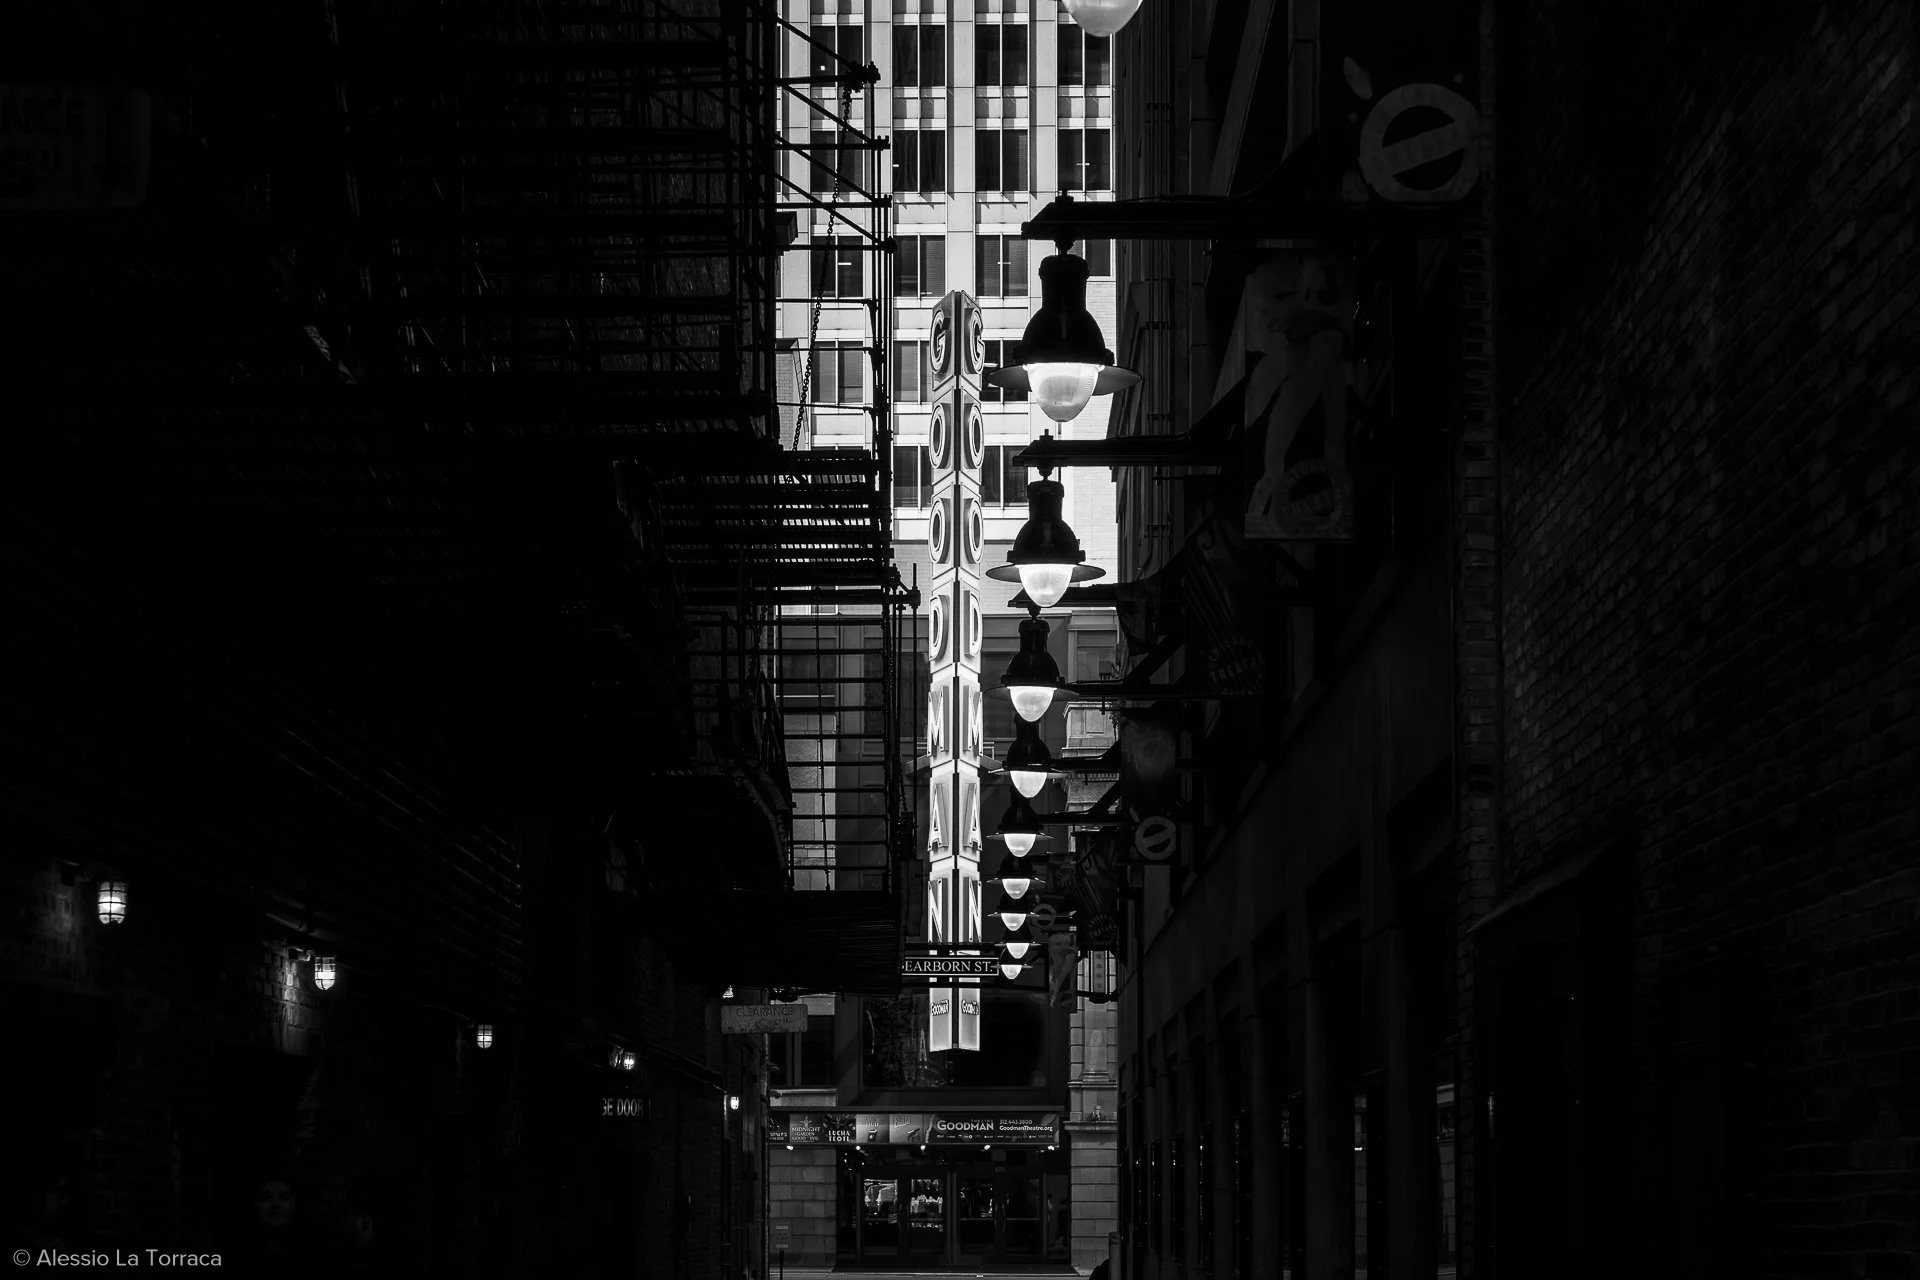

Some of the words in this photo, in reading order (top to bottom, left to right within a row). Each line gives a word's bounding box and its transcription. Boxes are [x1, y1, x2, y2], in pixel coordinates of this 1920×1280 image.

[928, 308, 951, 945] GOODMAN
[963, 308, 984, 945] GOODMAN
[902, 960, 971, 972] EARBORN
[974, 960, 993, 972] ST.
[735, 1006, 794, 1017] CLEARANCE
[617, 1097, 645, 1118] DOOR
